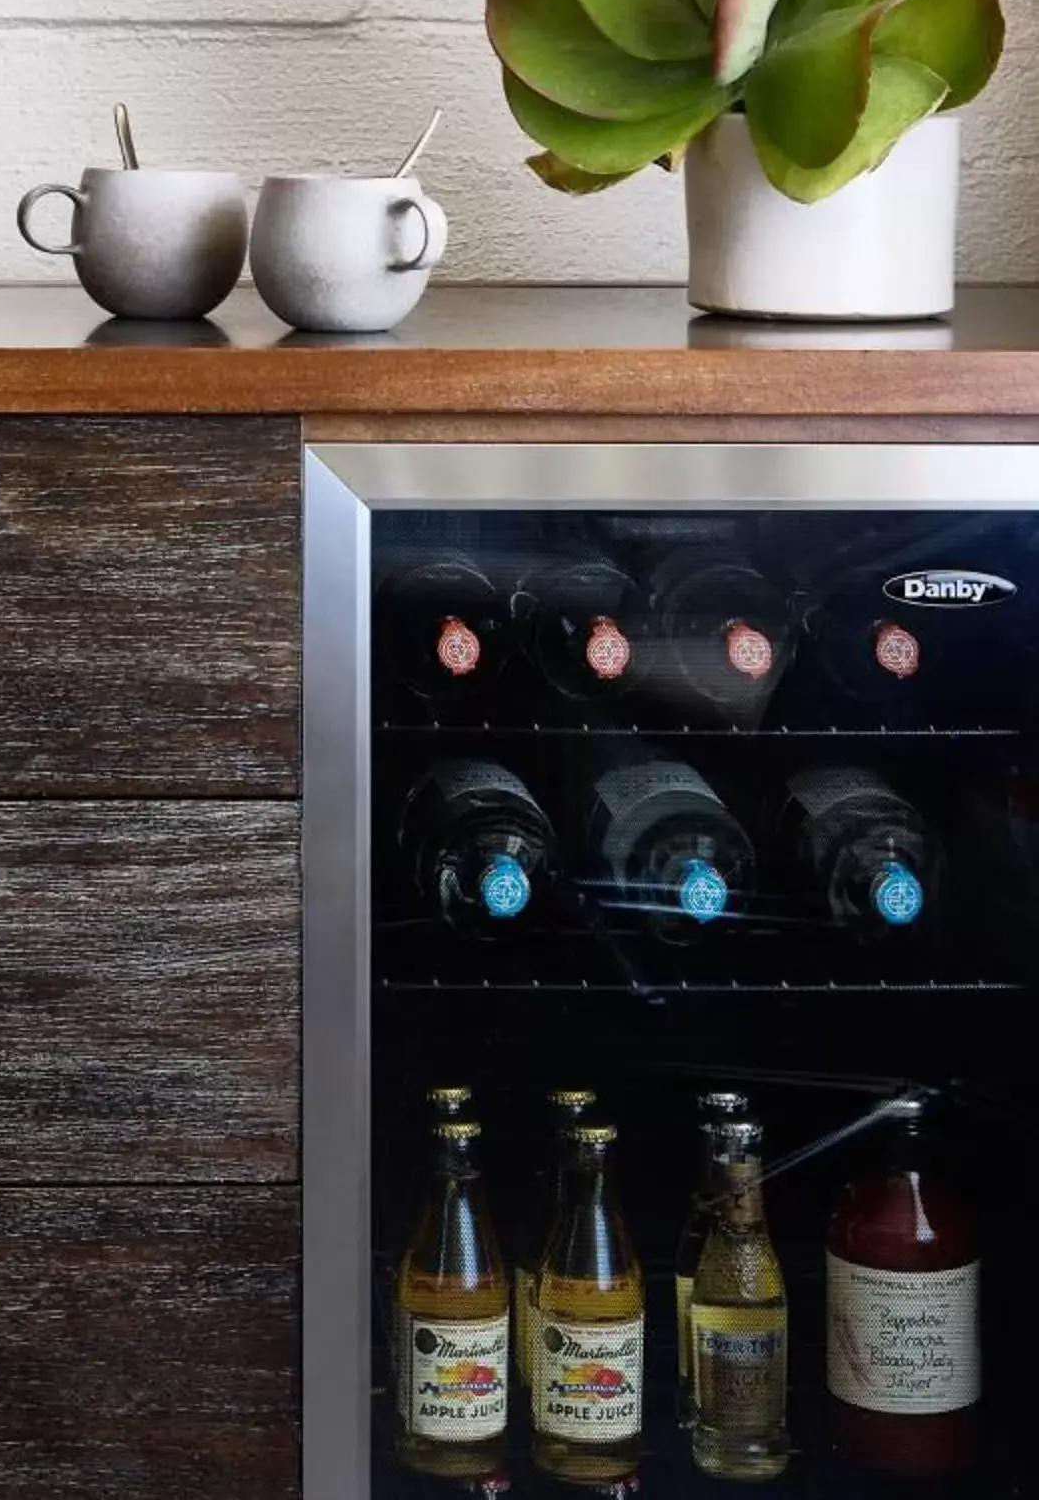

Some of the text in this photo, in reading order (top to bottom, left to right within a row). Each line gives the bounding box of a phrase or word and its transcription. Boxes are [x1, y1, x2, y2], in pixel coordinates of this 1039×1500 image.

[904, 578, 986, 603] Danby
[420, 1402, 466, 1419] APPLE
[547, 1401, 636, 1420] APPLE JUICE
